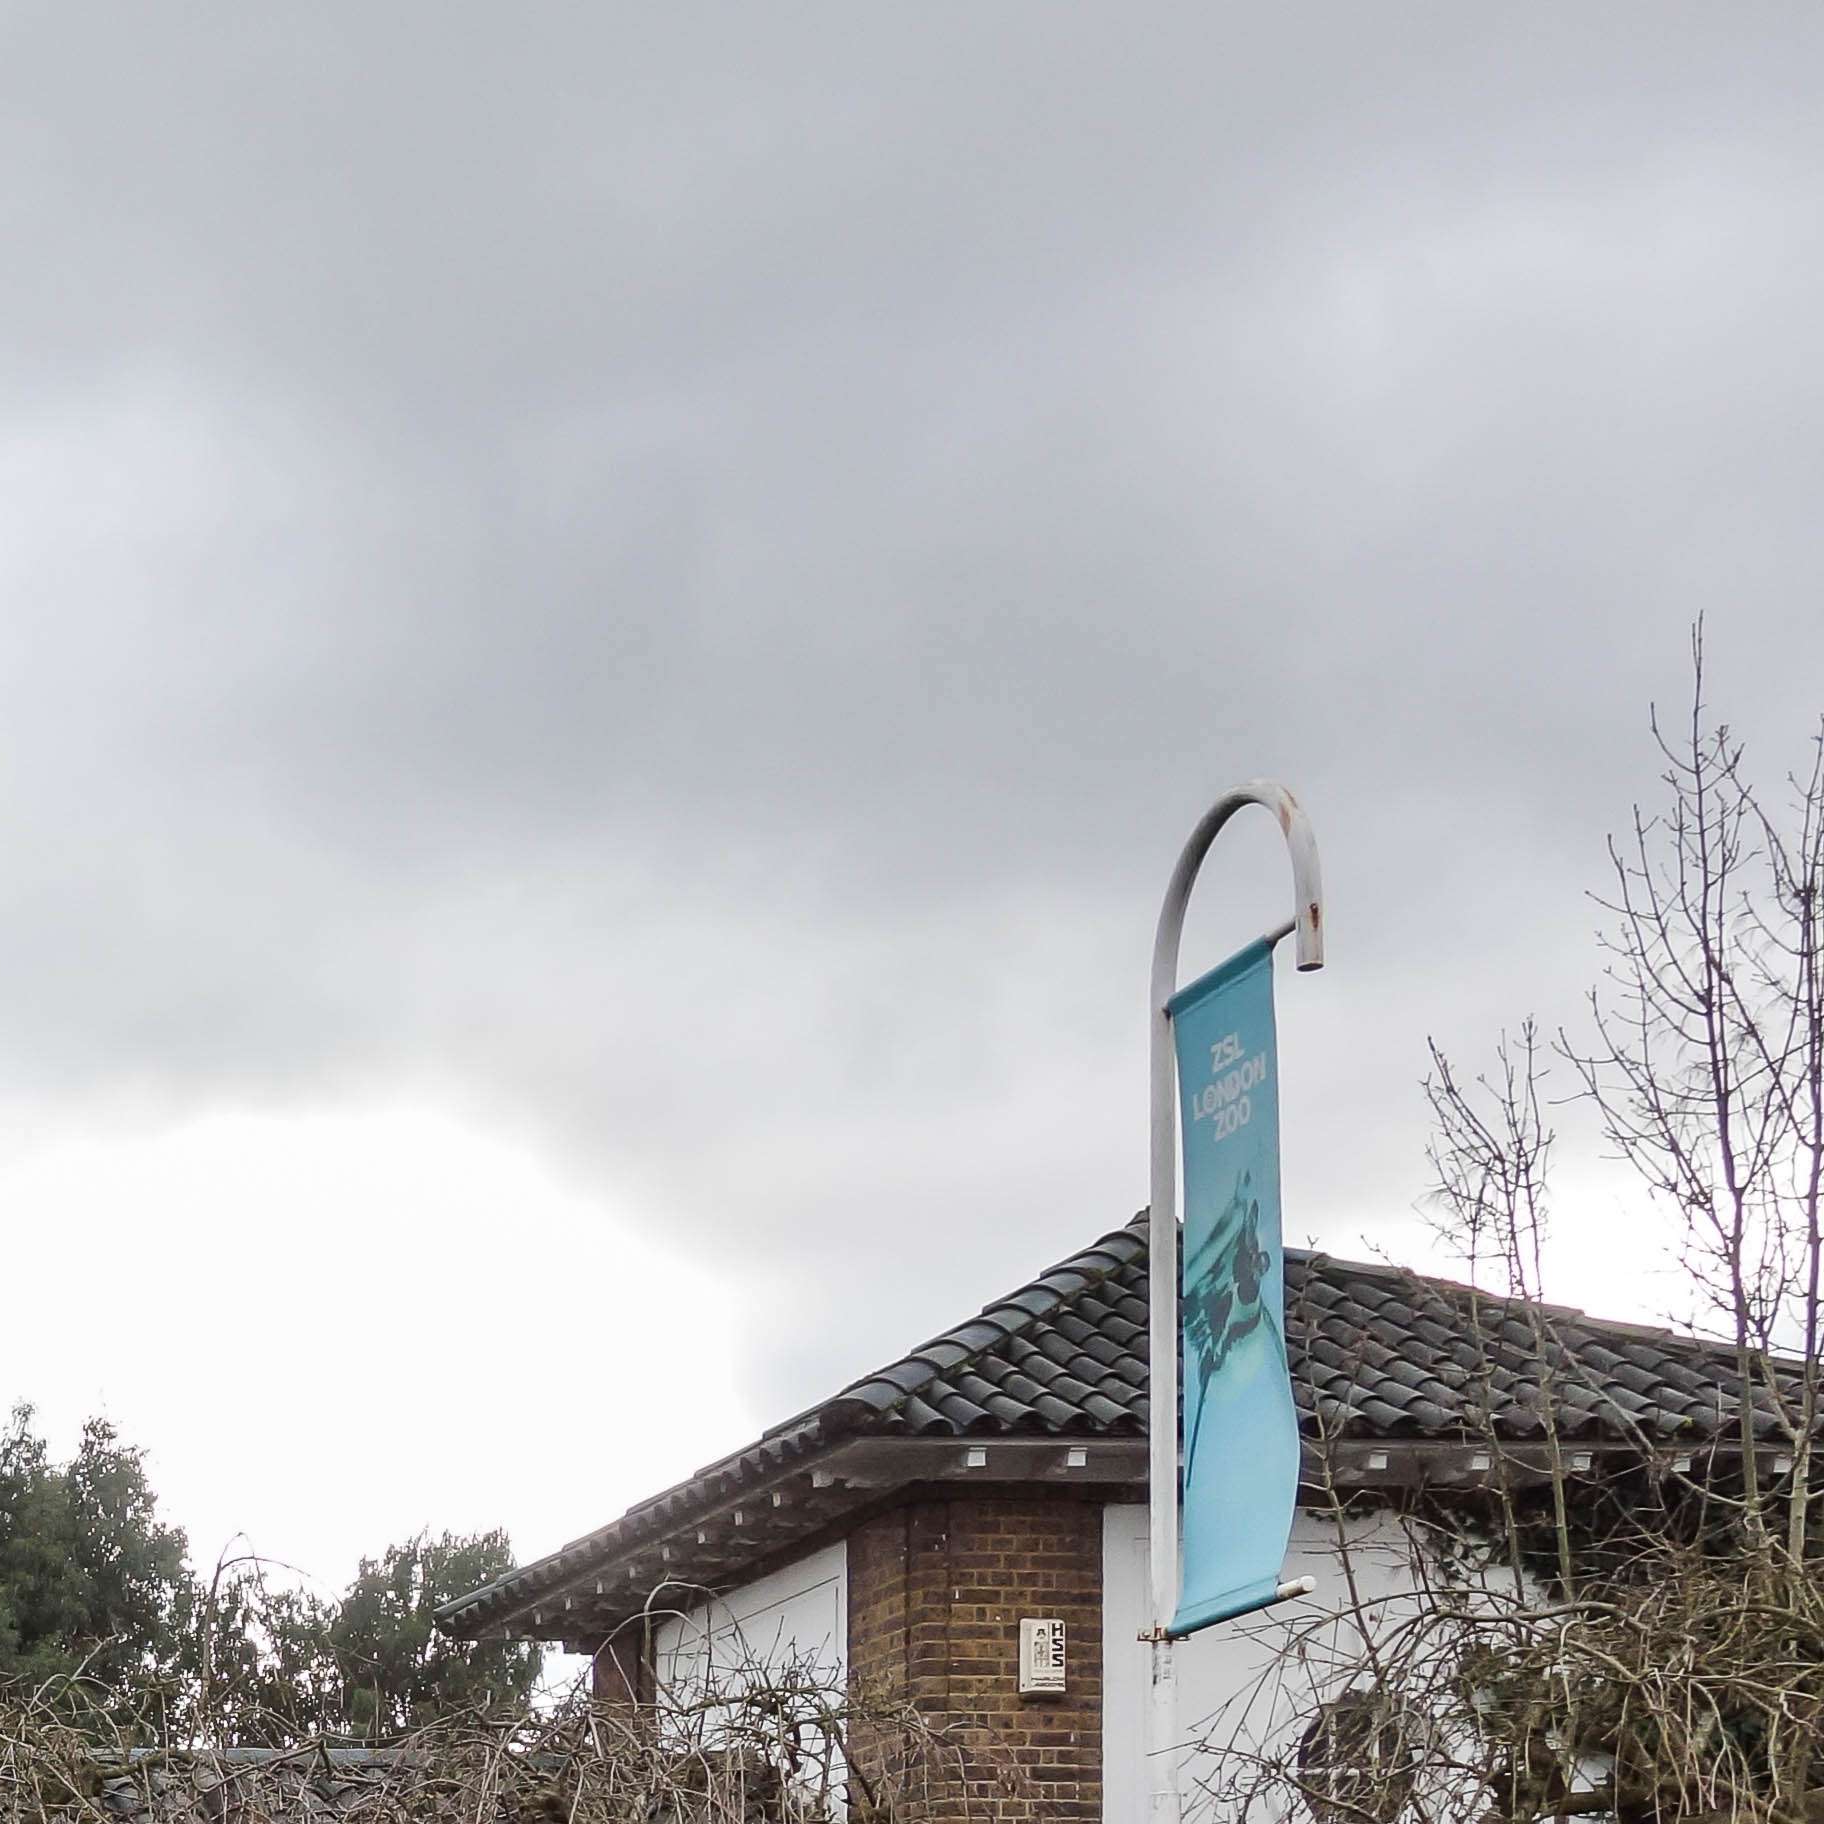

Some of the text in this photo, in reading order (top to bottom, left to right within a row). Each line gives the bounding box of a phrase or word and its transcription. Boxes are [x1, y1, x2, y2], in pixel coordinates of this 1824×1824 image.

[1210, 1031, 1246, 1074] ZSL
[1193, 1051, 1267, 1121] LONDON
[1213, 1095, 1251, 1143] ZOO
